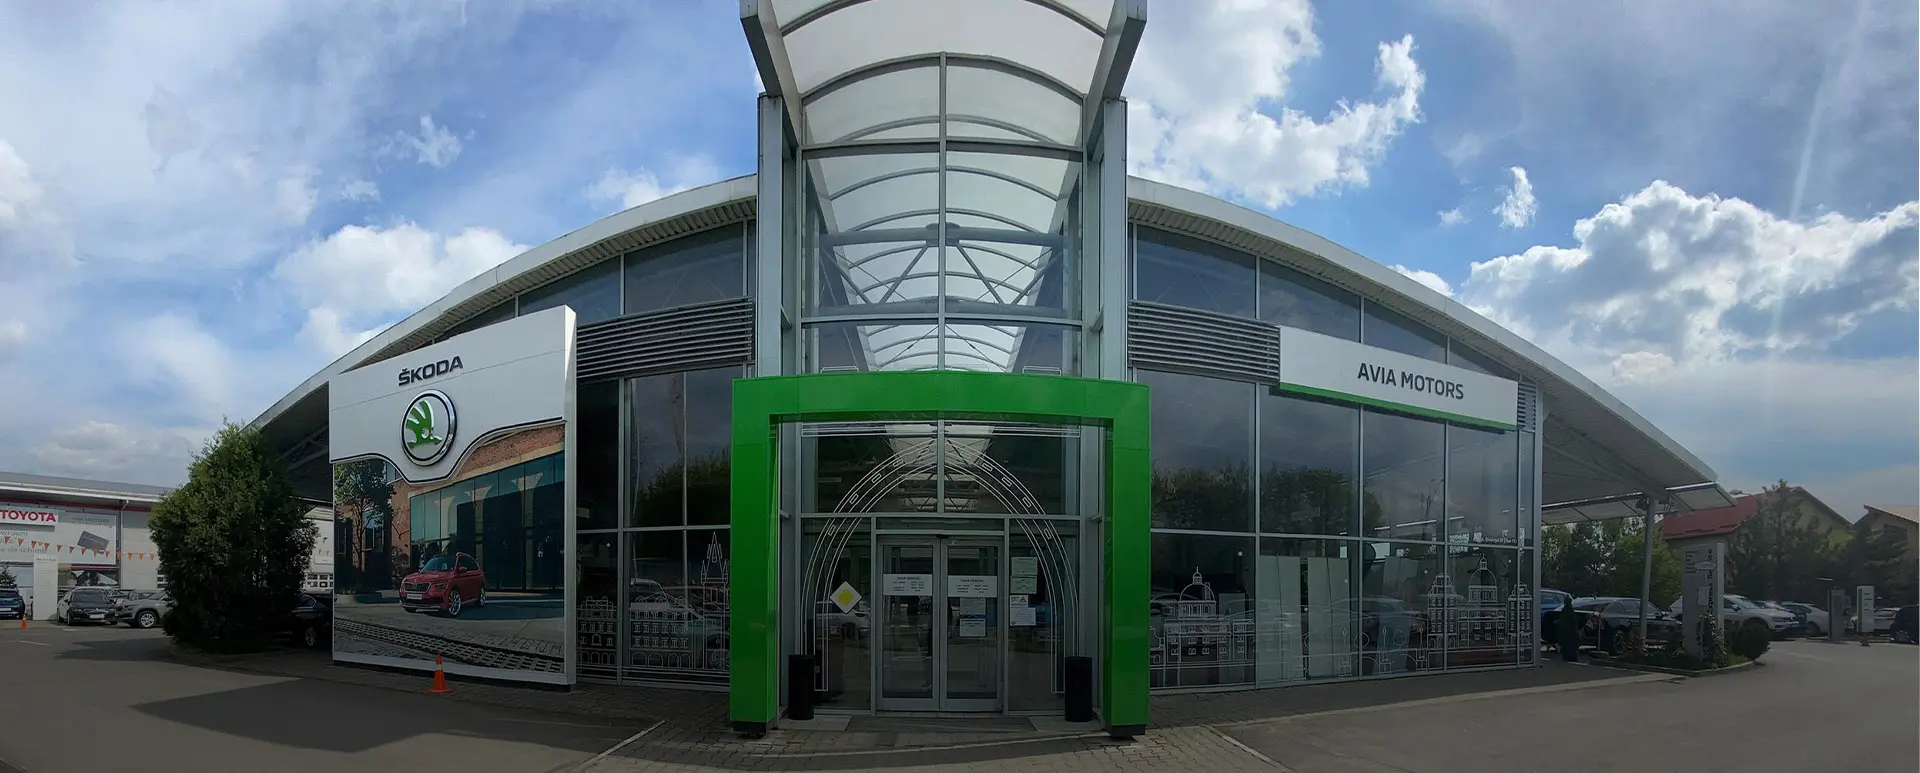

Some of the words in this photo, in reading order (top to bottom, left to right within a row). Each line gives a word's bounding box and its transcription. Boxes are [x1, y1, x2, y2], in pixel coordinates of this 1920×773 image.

[399, 356, 463, 386] ŠKODA
[1357, 362, 1397, 386] AVIA
[1401, 371, 1464, 400] MOTORS
[0, 510, 56, 522] TOYOTA
